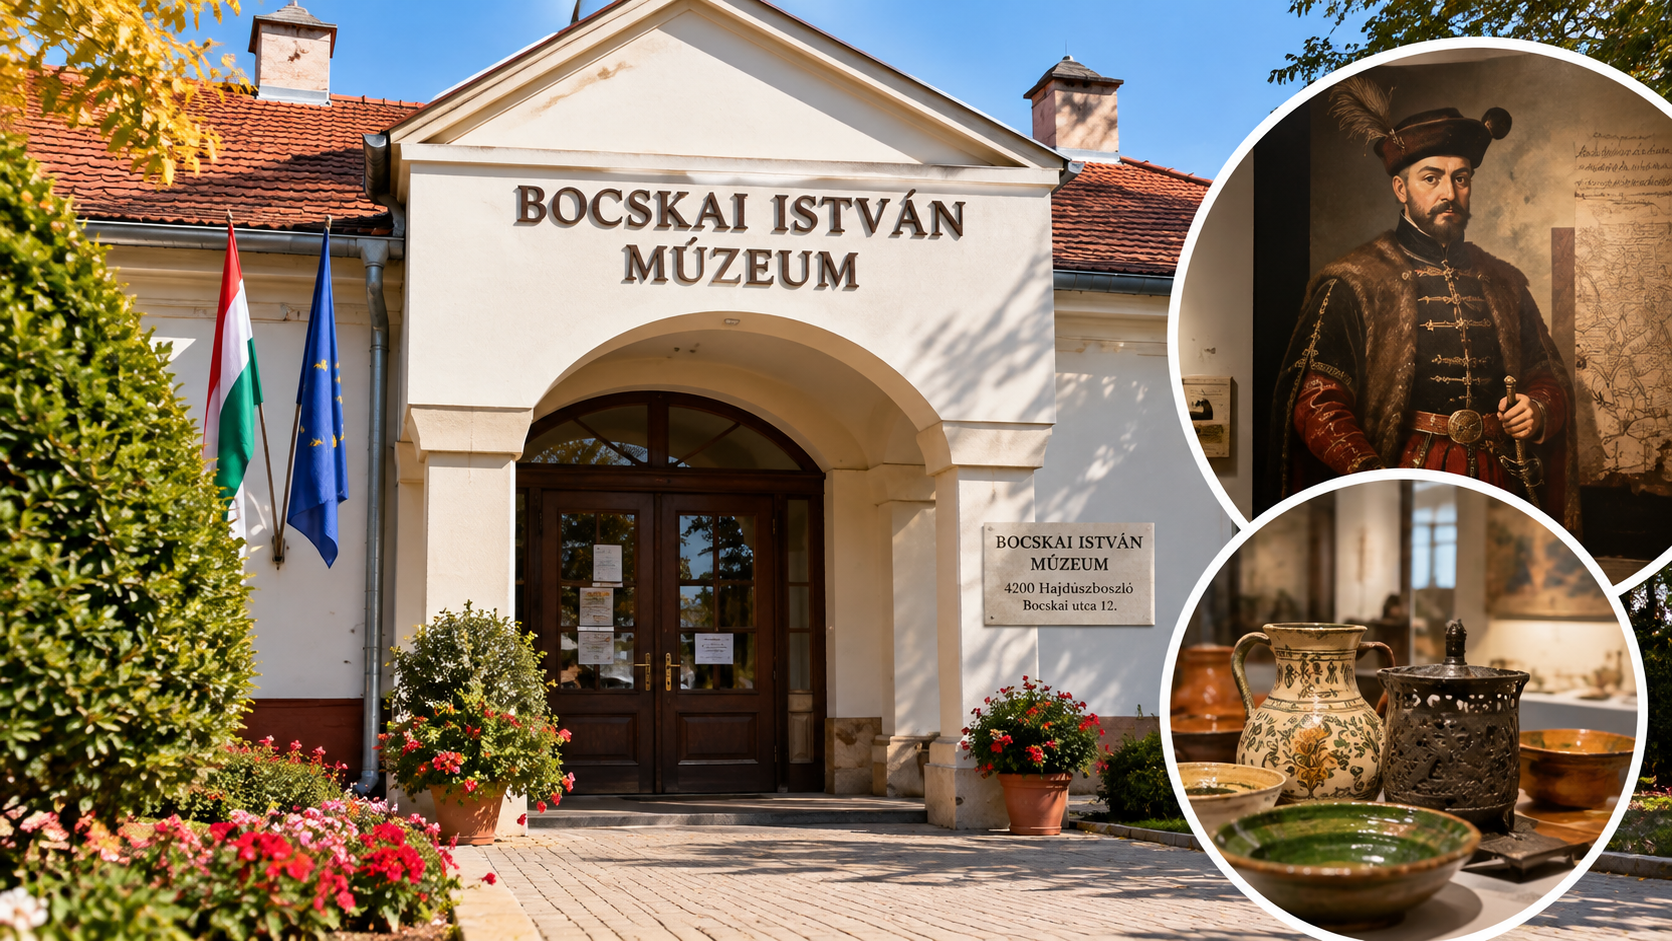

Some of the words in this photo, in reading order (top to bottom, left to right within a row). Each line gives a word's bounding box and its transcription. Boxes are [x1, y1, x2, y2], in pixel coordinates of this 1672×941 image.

[515, 185, 749, 232] BOCSKAI
[771, 189, 967, 238] ISTVÁN
[622, 237, 859, 290] MÚZEUM
[996, 536, 1073, 549] BOCSKAI
[1079, 533, 1143, 549] ISTVÁN
[1031, 554, 1109, 571] MÚZEUM
[1004, 582, 1035, 594] 4200
[1023, 600, 1069, 611] Bocskai
[1072, 601, 1097, 611] utca
[1101, 600, 1117, 611] 12.
